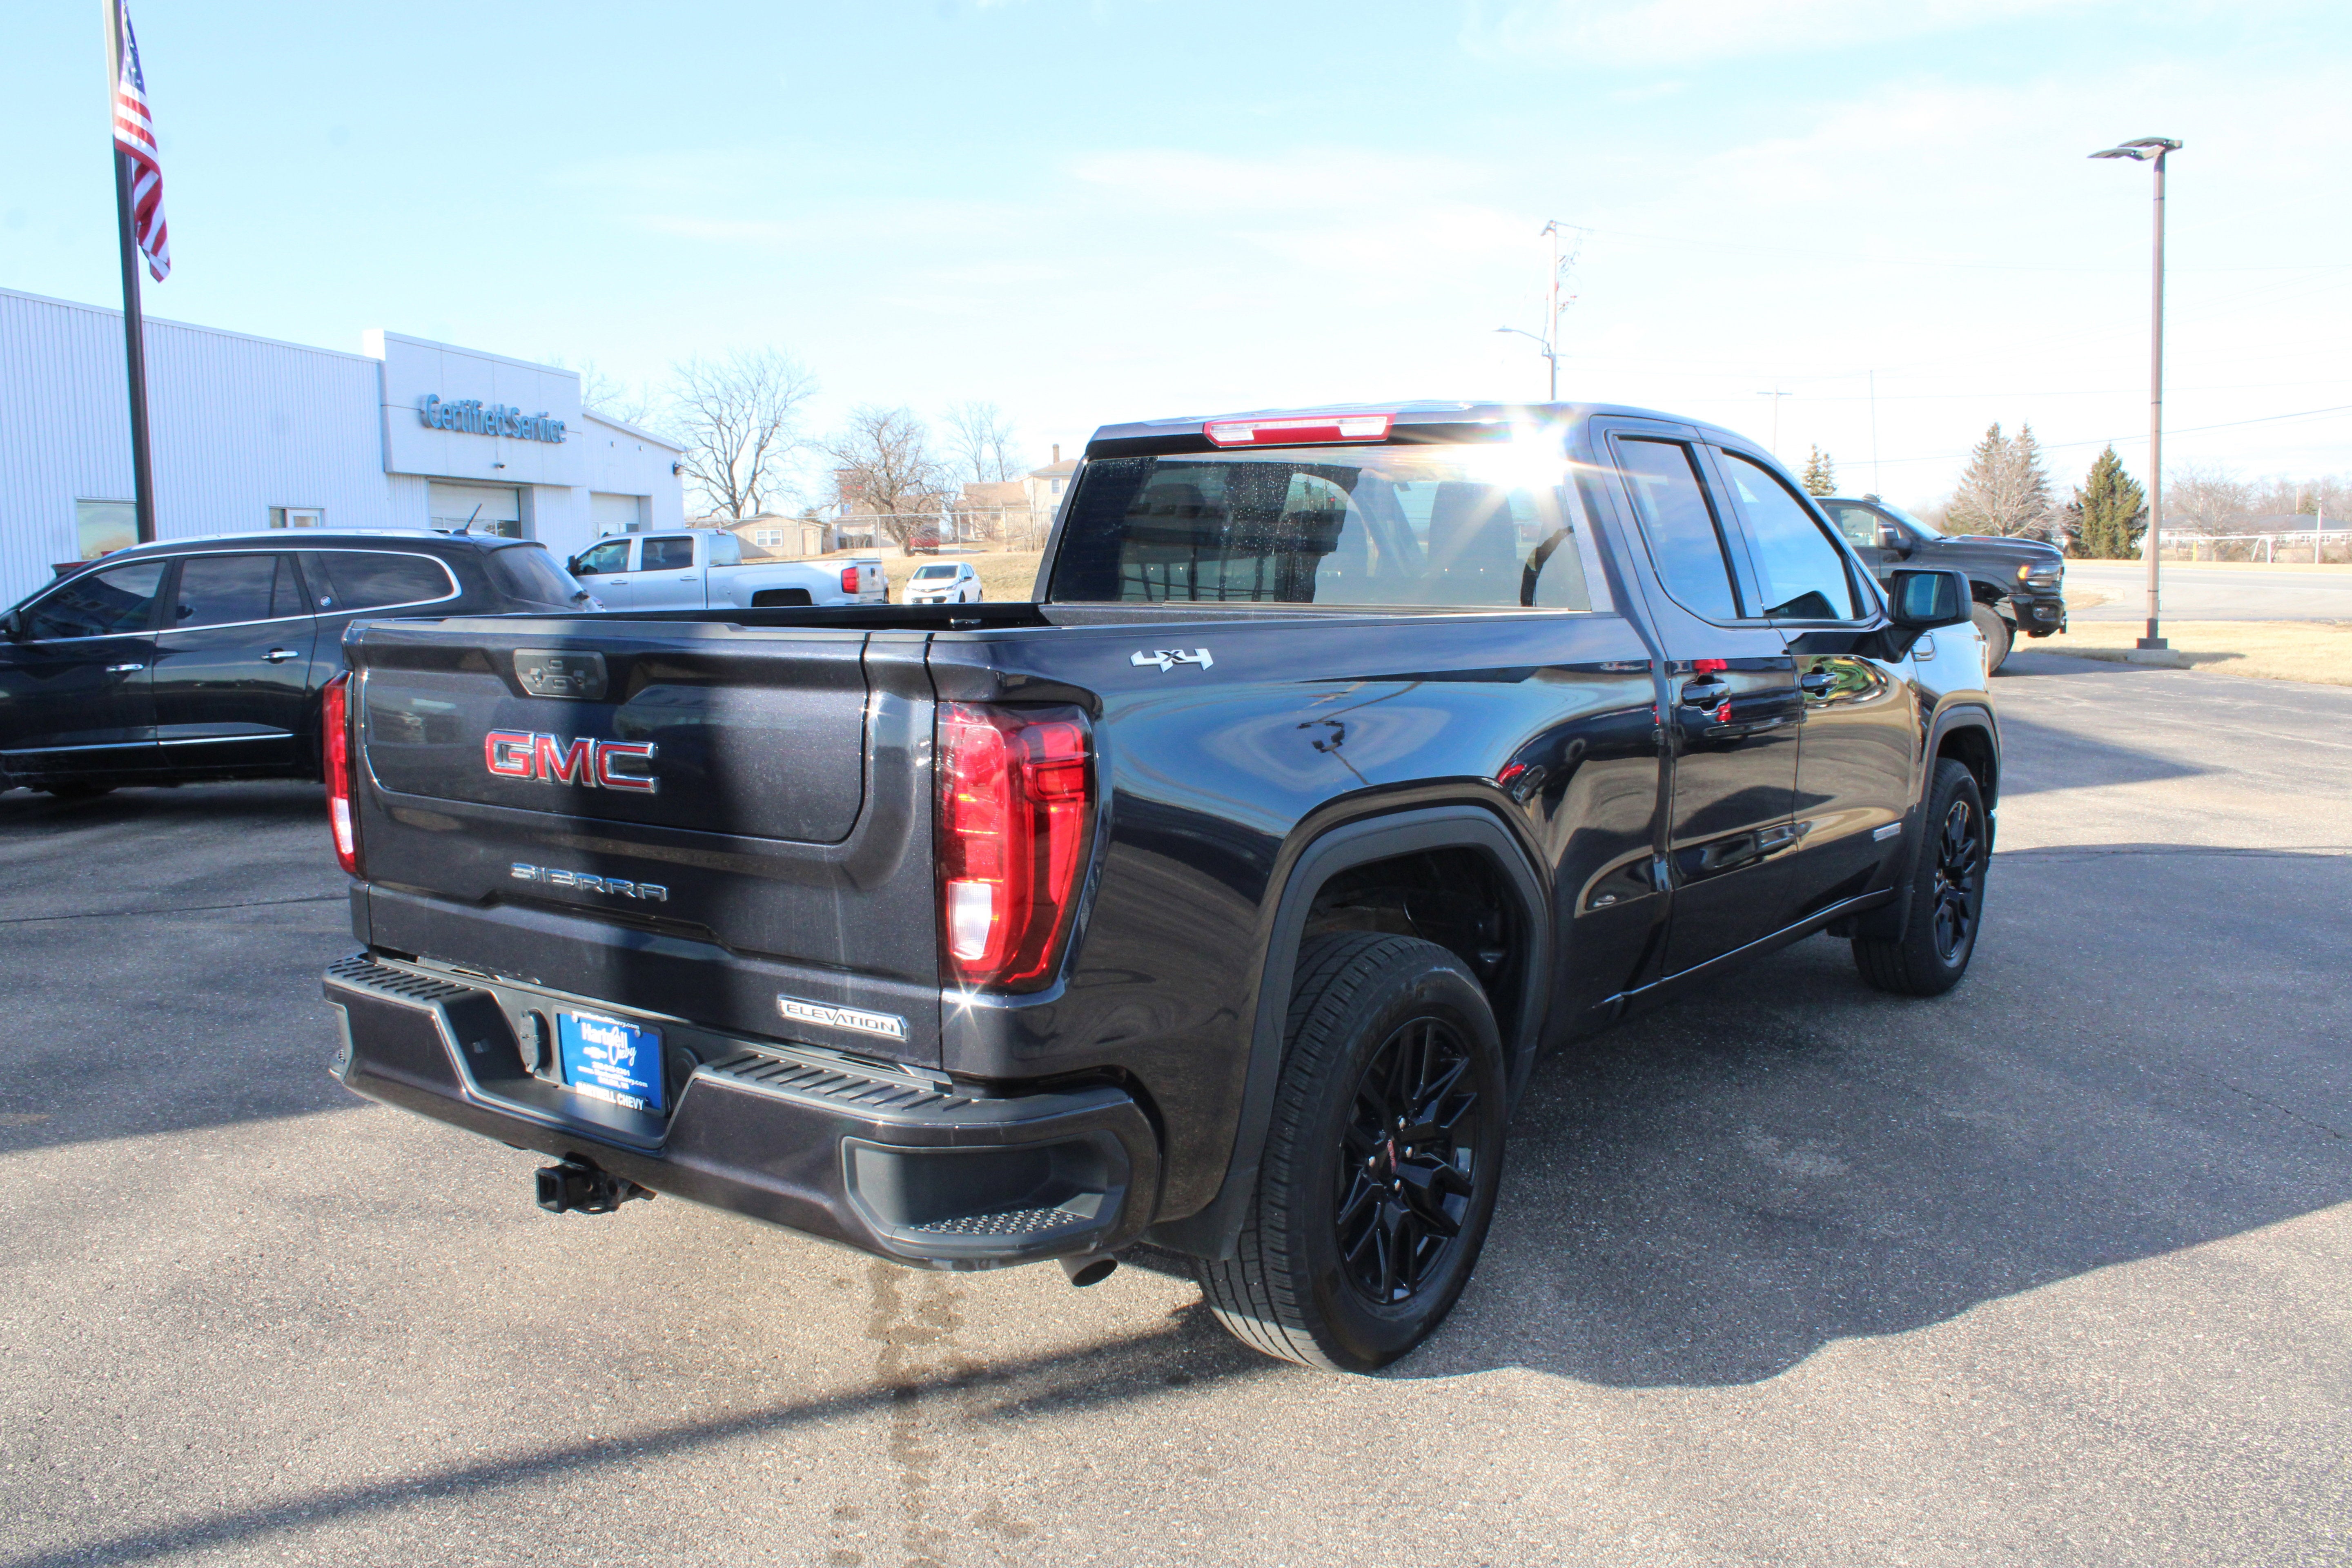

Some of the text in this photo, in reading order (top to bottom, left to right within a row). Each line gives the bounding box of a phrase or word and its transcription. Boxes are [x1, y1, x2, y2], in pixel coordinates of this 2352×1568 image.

[422, 394, 567, 443] Certified Service
[485, 728, 659, 794] GMC
[511, 862, 669, 902] SIERRA
[786, 1004, 895, 1032] ELEVATION
[617, 1093, 644, 1111] CHEVY
